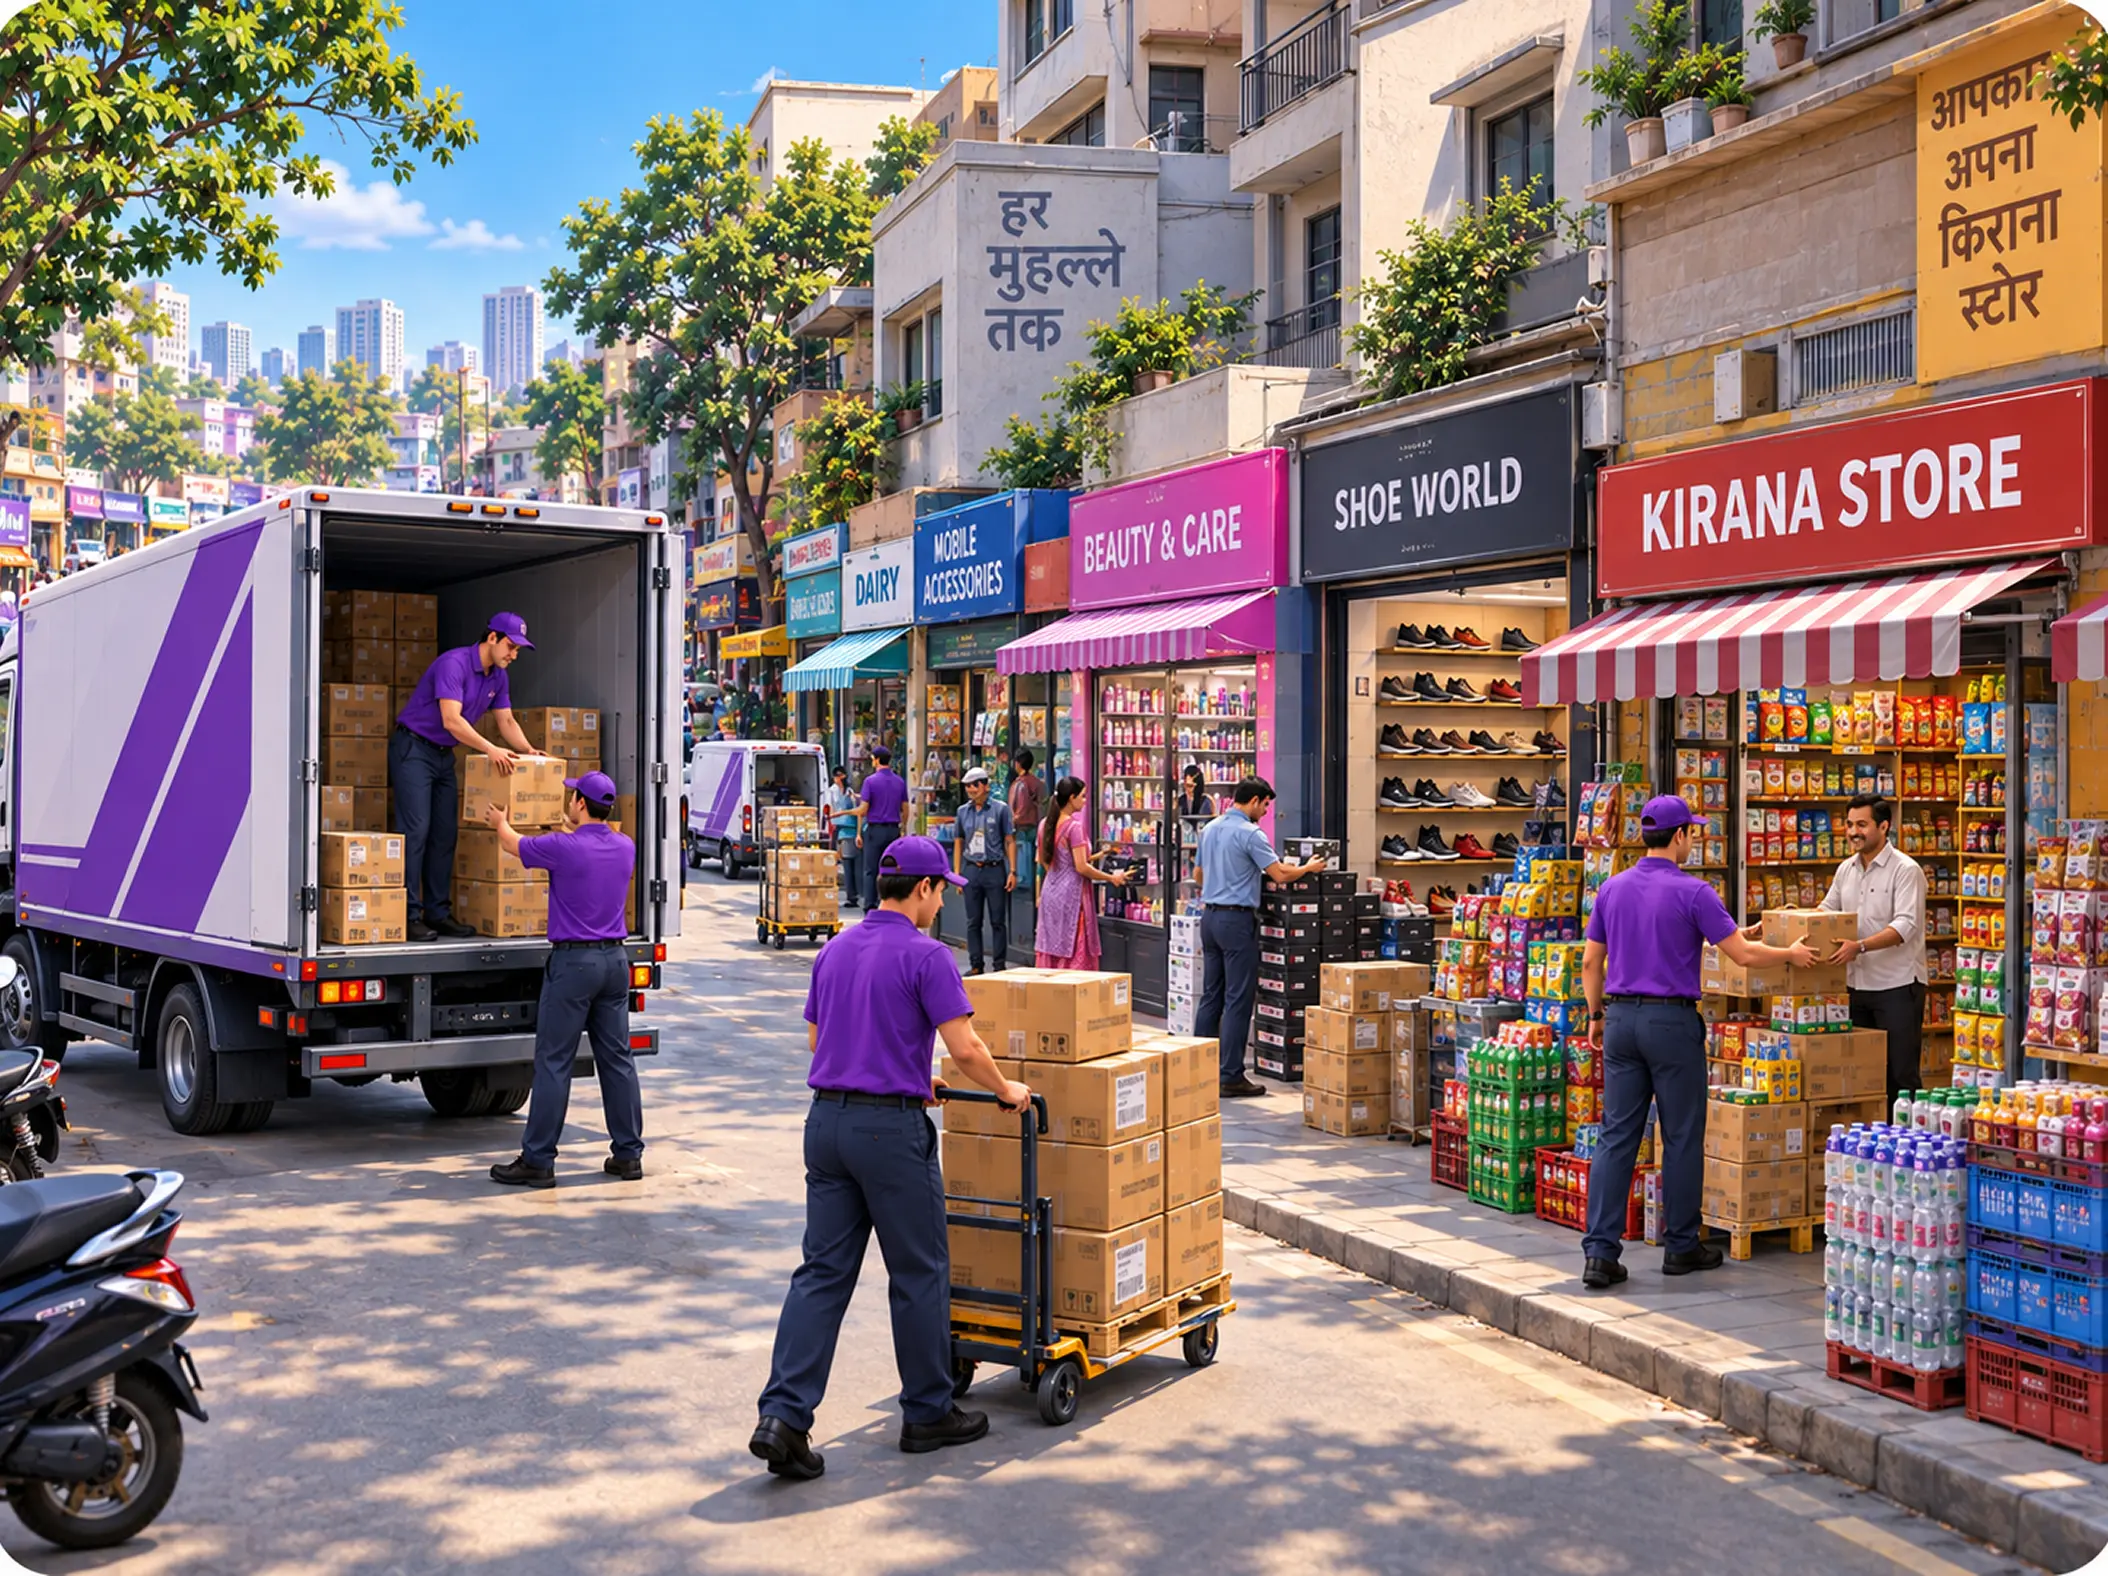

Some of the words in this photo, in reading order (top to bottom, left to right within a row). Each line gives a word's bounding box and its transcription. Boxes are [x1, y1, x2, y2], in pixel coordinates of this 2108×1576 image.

[1931, 50, 2051, 131] आपका
[1945, 124, 2038, 191] अपना
[997, 190, 1053, 238] हर
[1938, 189, 2062, 269] किराना
[985, 228, 1127, 303] मुहल्ले
[1959, 262, 2044, 332] स्टोर
[984, 308, 1065, 353] तक
[1334, 478, 1402, 531] SHOE
[1411, 456, 1522, 518] WORLD
[1643, 467, 1824, 553] KIRANA
[1838, 434, 2022, 528] STORE
[934, 523, 977, 564] MOBILE
[1084, 522, 1155, 574] BEAUTY
[1160, 519, 1176, 561] &
[1182, 505, 1242, 557] CARE
[855, 565, 900, 607] DAIRY
[923, 559, 1003, 606] ACCESSORIES
